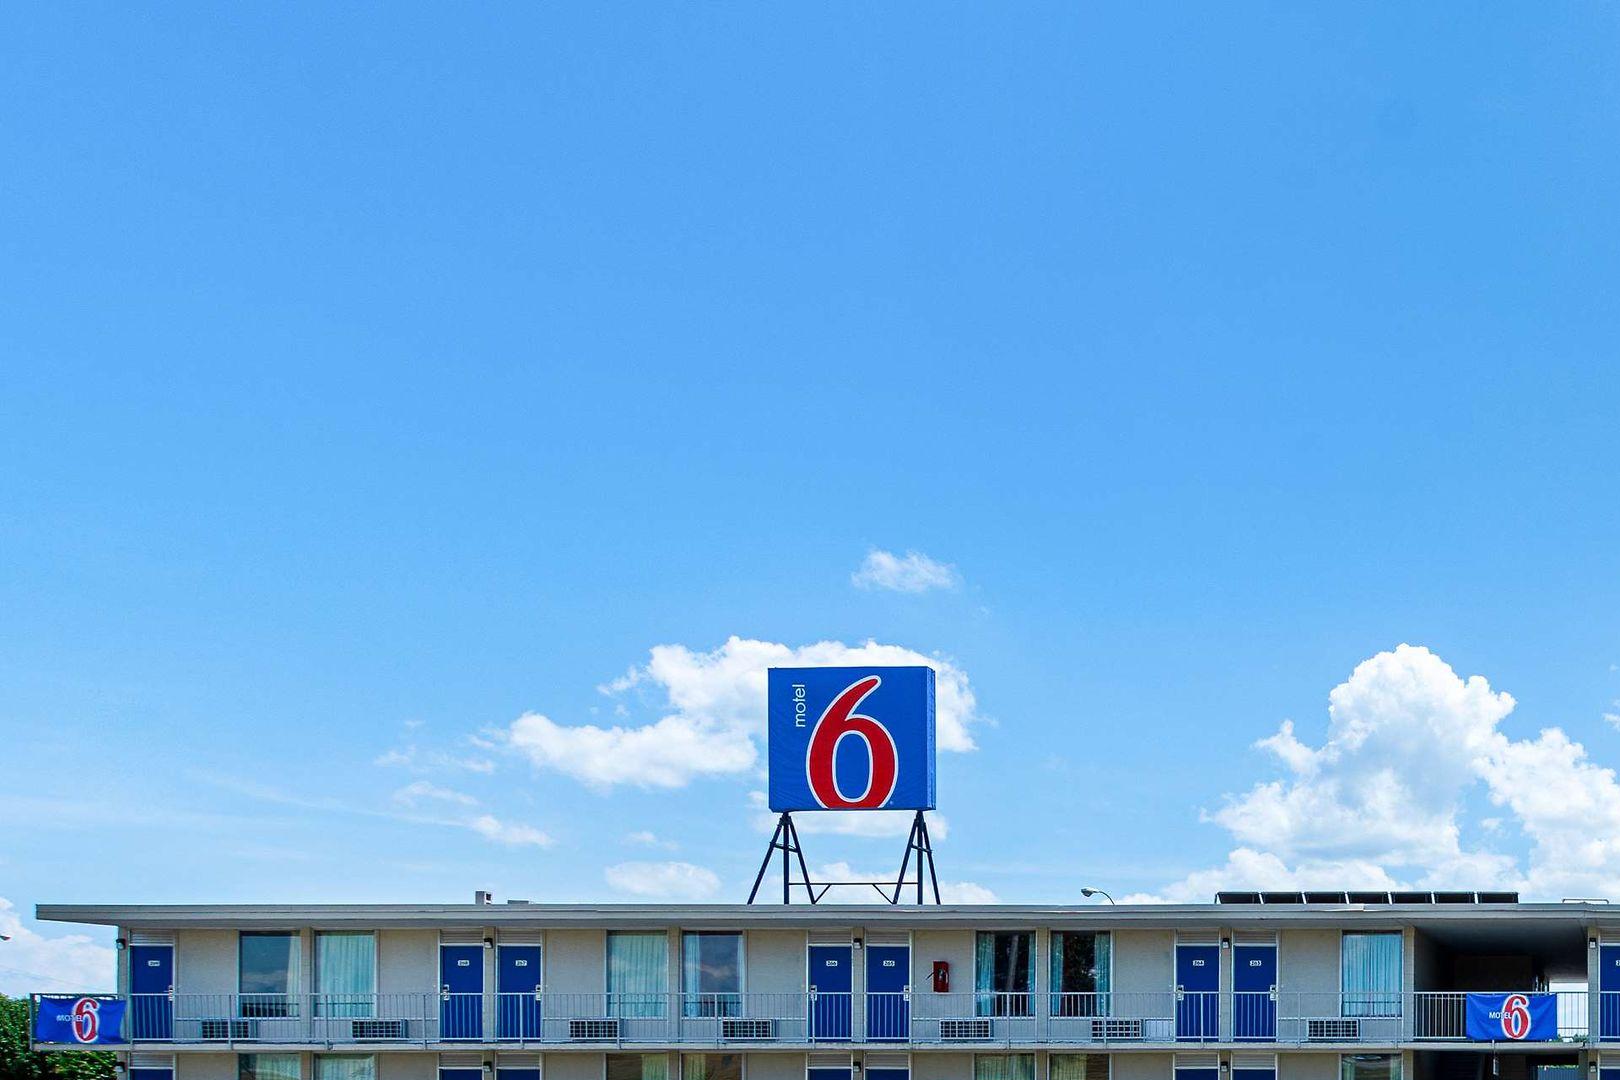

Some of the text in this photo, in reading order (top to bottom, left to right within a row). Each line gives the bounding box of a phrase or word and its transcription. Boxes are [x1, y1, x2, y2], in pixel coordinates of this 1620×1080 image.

[792, 675, 899, 809] motel 6
[56, 997, 100, 1044] MOTEL 6
[1488, 994, 1532, 1040] MOTEL 6
